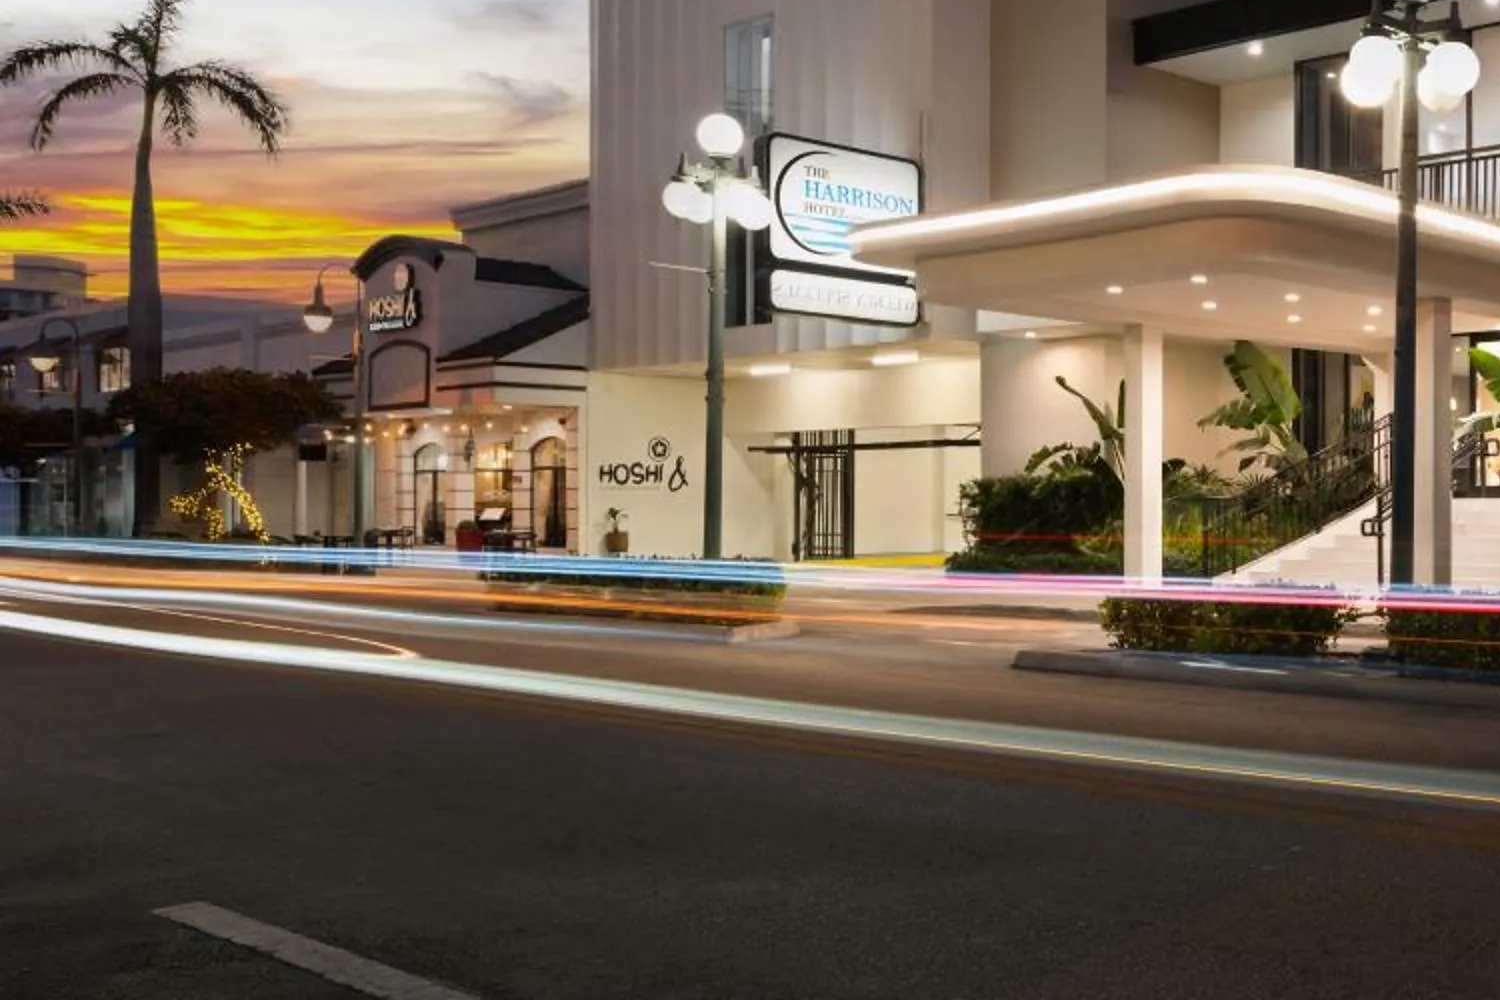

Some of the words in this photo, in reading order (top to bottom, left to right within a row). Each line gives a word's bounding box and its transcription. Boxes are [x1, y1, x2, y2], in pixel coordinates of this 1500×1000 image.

[803, 165, 829, 179] THE
[804, 179, 913, 214] HARRISON
[802, 202, 846, 218] HOTEL
[599, 461, 664, 485] HOSHI
[668, 455, 689, 492] &
